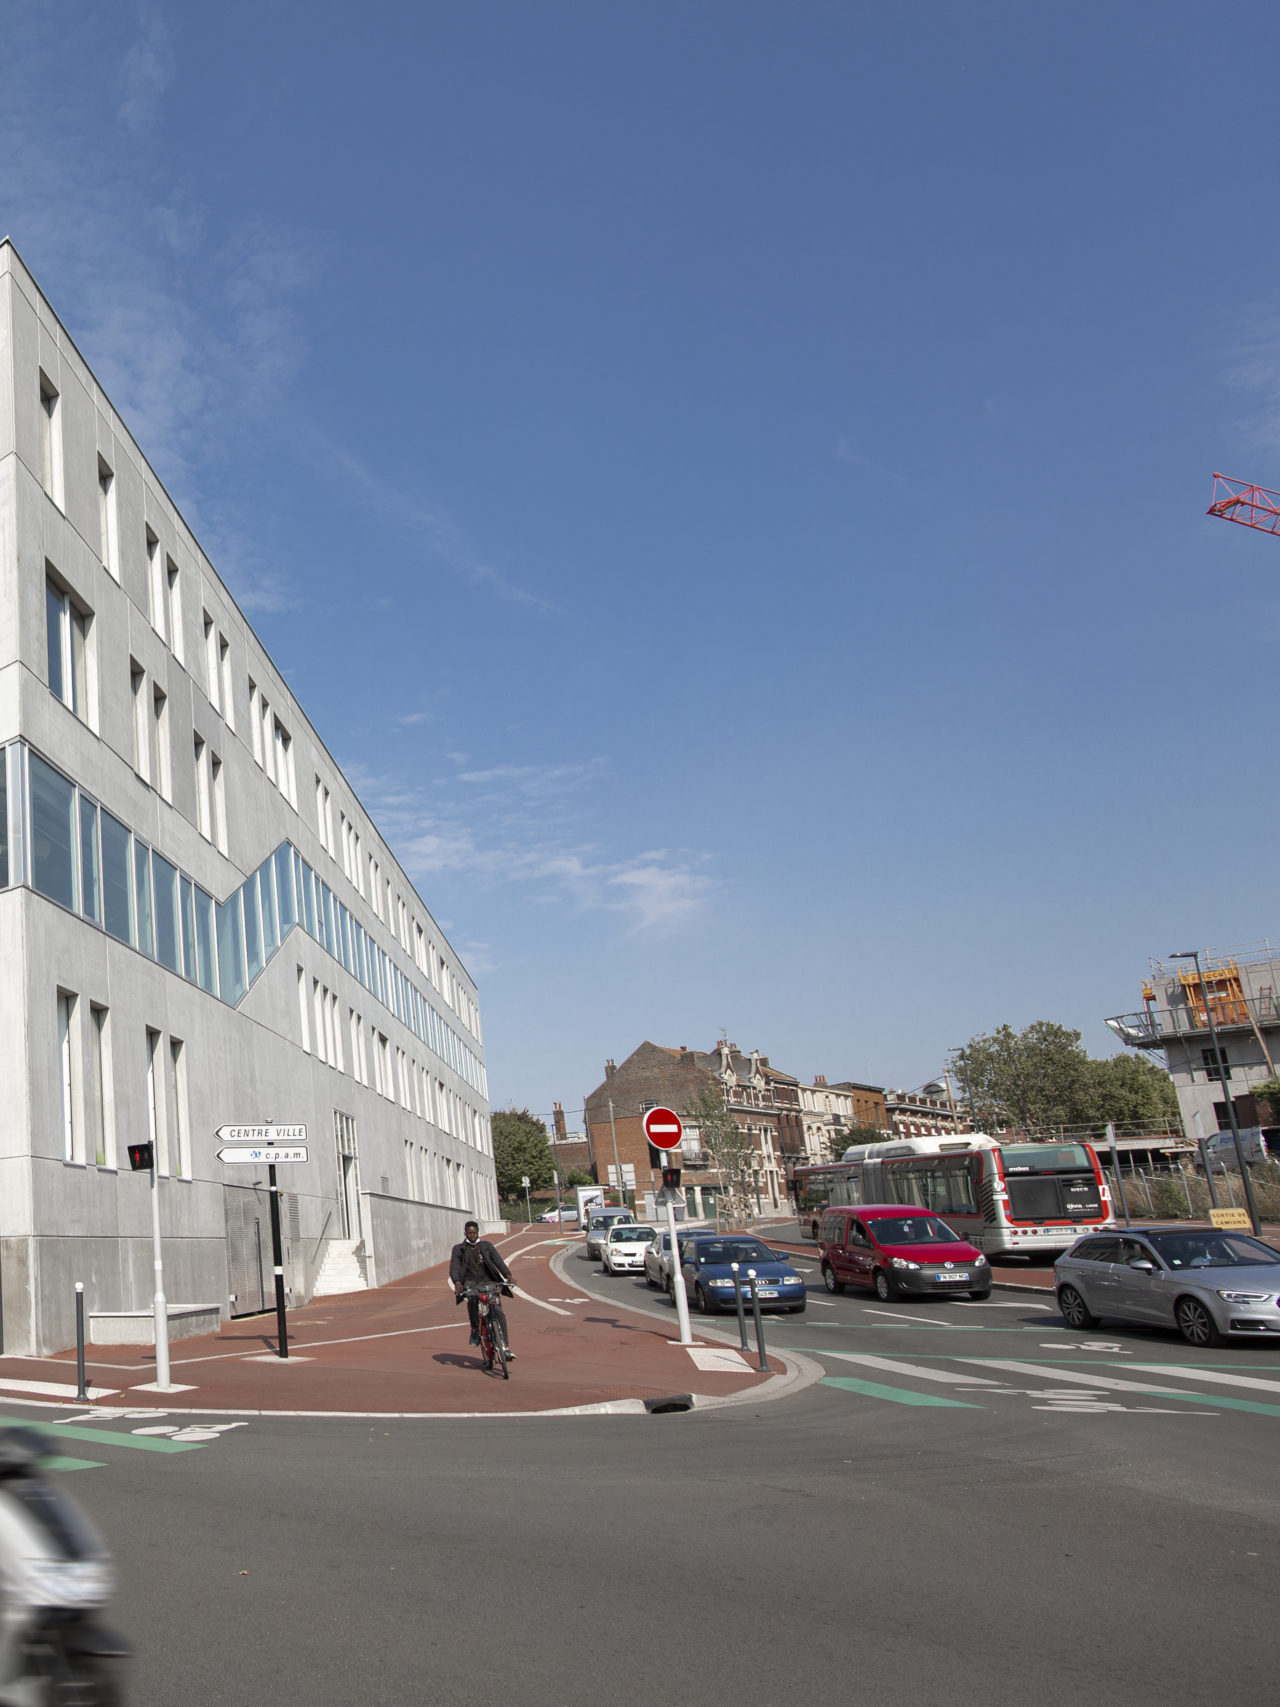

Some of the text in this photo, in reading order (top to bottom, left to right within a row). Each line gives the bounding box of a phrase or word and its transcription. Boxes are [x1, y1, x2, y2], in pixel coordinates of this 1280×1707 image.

[229, 1127, 304, 1138] CENTRE VILLE
[265, 1152, 304, 1161] c.p.a.m.
